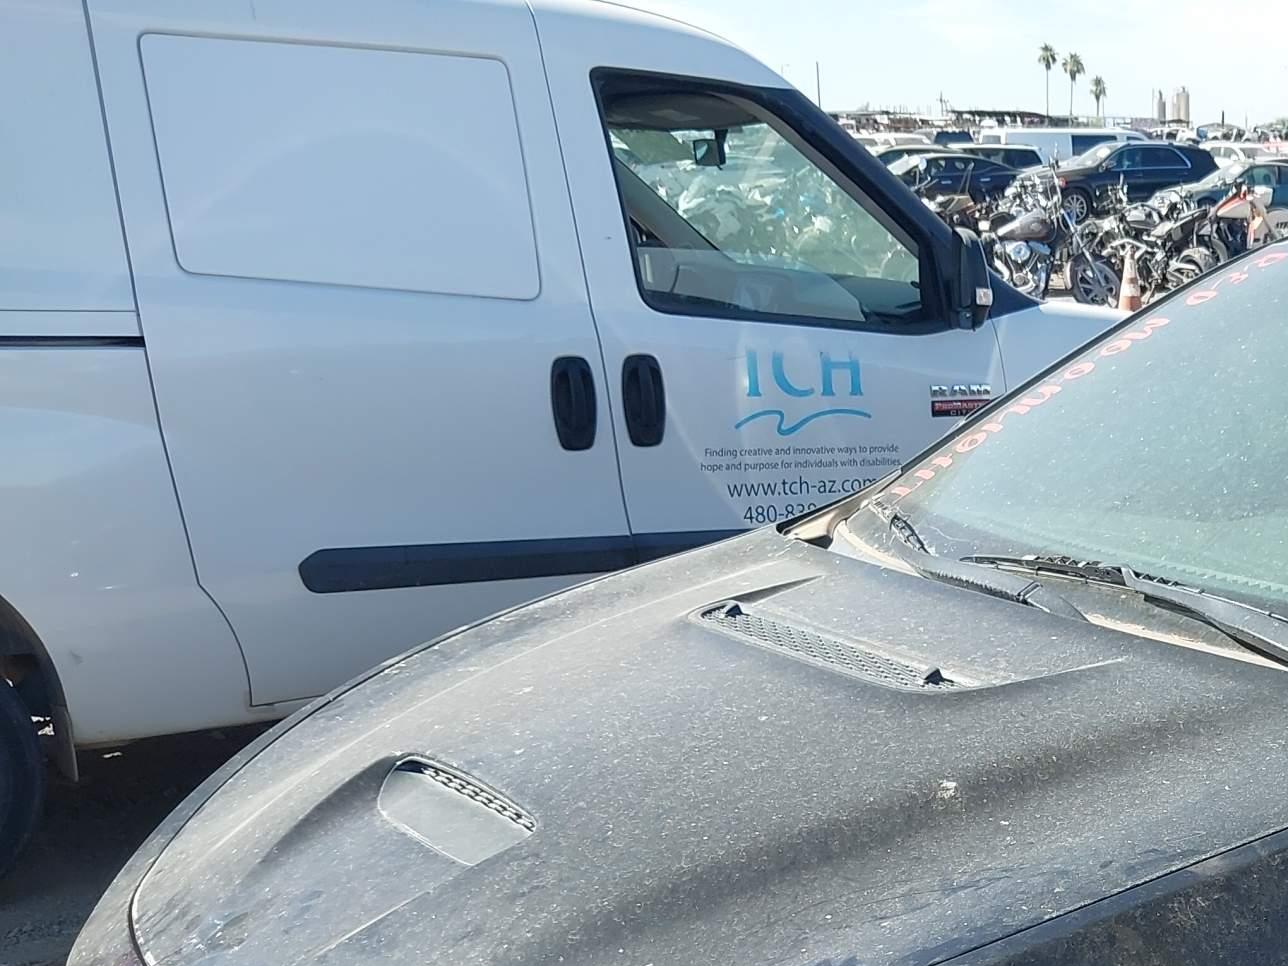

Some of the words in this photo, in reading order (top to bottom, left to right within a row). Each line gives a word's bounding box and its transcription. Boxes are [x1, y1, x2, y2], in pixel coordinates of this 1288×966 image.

[930, 384, 991, 397] RAM
[704, 447, 738, 459] Finding
[739, 447, 773, 457] creative
[774, 445, 791, 456] and
[793, 446, 835, 455] innovative
[837, 446, 857, 455] ways
[859, 444, 867, 453] to
[869, 443, 900, 454] provide
[700, 462, 724, 473] hope
[725, 462, 742, 471] and
[744, 461, 779, 472] purpose
[781, 459, 792, 469] for
[794, 458, 838, 468] individuals
[840, 457, 858, 467] with
[727, 475, 877, 498] www.tch-az.com
